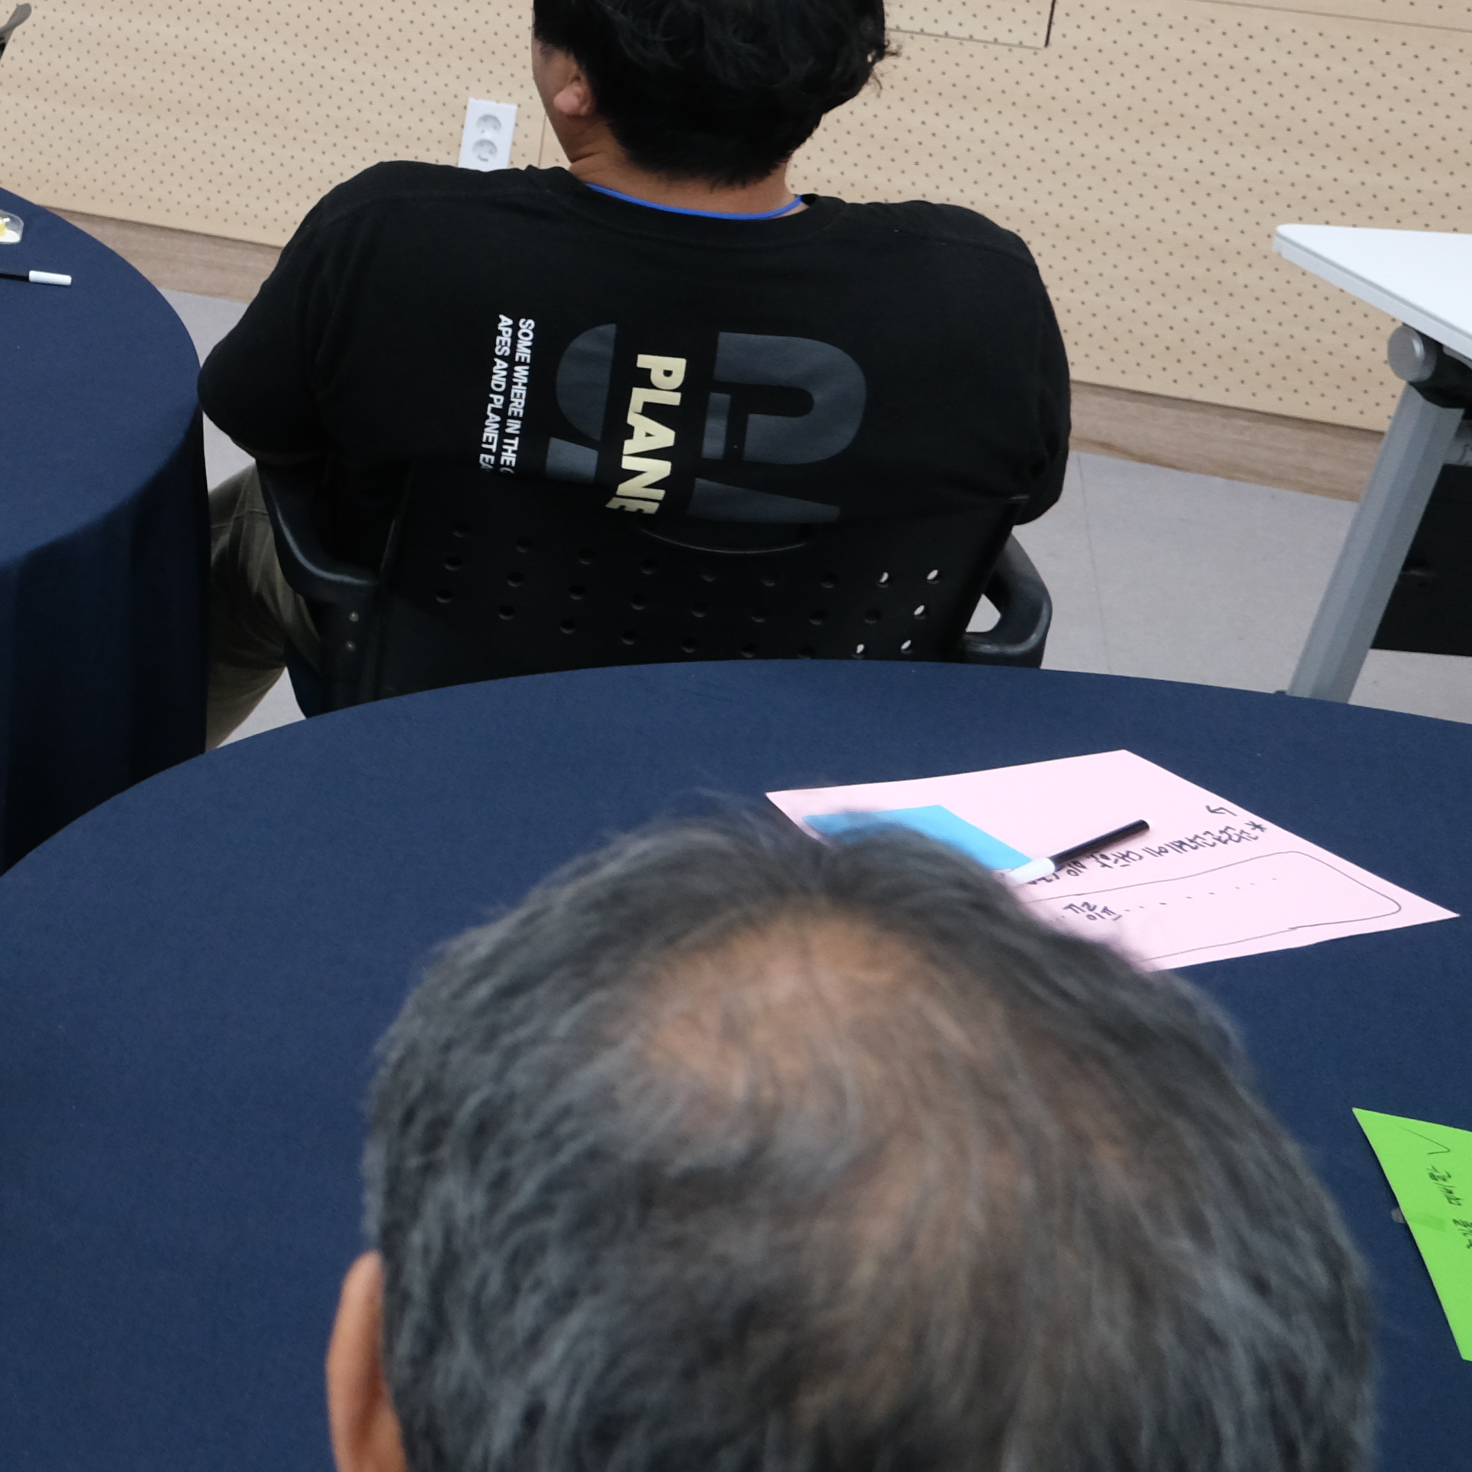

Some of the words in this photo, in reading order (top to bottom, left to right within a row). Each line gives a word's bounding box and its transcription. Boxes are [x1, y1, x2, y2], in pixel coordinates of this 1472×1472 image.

[495, 314, 513, 356] APES
[515, 318, 535, 363] SOME
[490, 358, 508, 392] AND
[508, 364, 530, 417] WHERE
[481, 394, 503, 452] PLANET
[507, 416, 521, 433] IN
[500, 435, 519, 468] THE
